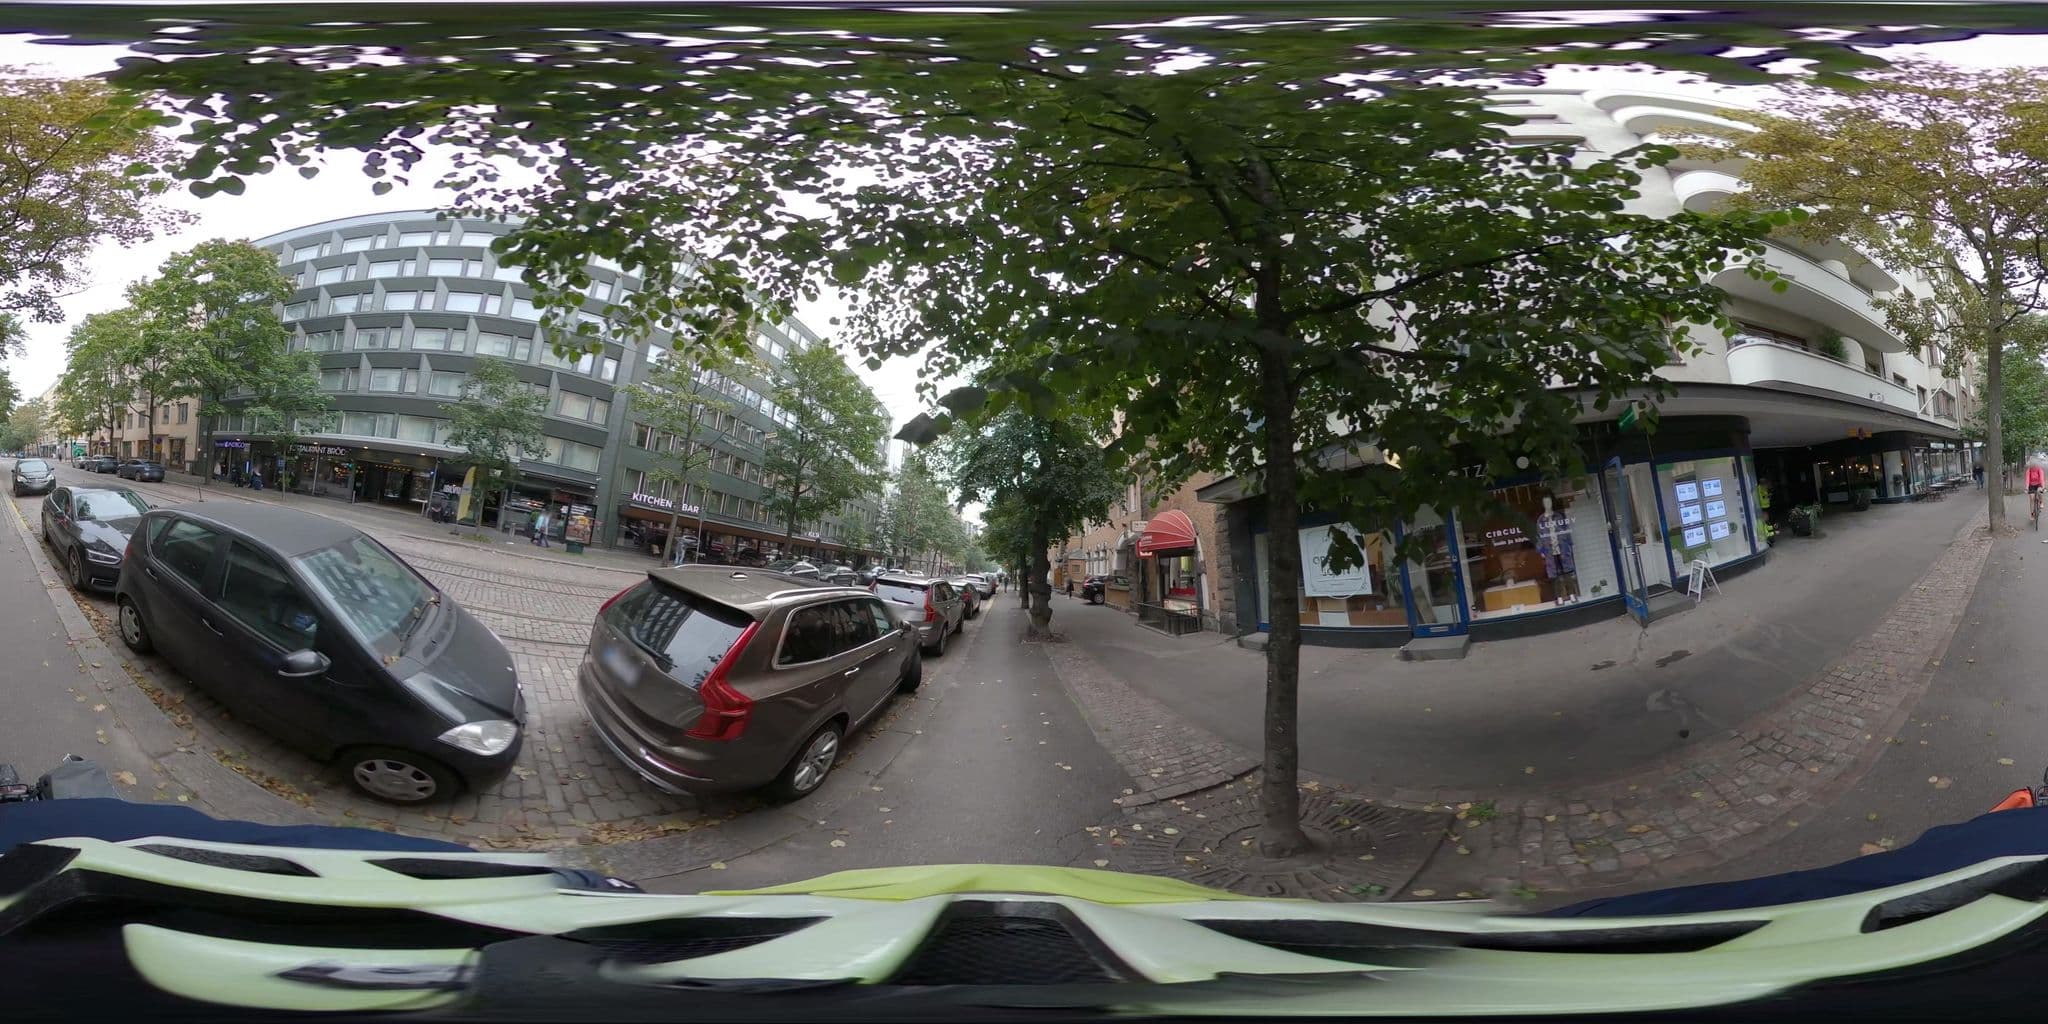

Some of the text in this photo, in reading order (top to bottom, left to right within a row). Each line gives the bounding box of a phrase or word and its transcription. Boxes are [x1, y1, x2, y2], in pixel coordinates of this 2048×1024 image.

[632, 491, 700, 514] KITCHEN BAR
[1485, 516, 1577, 539] CIRCUL LUXURY
